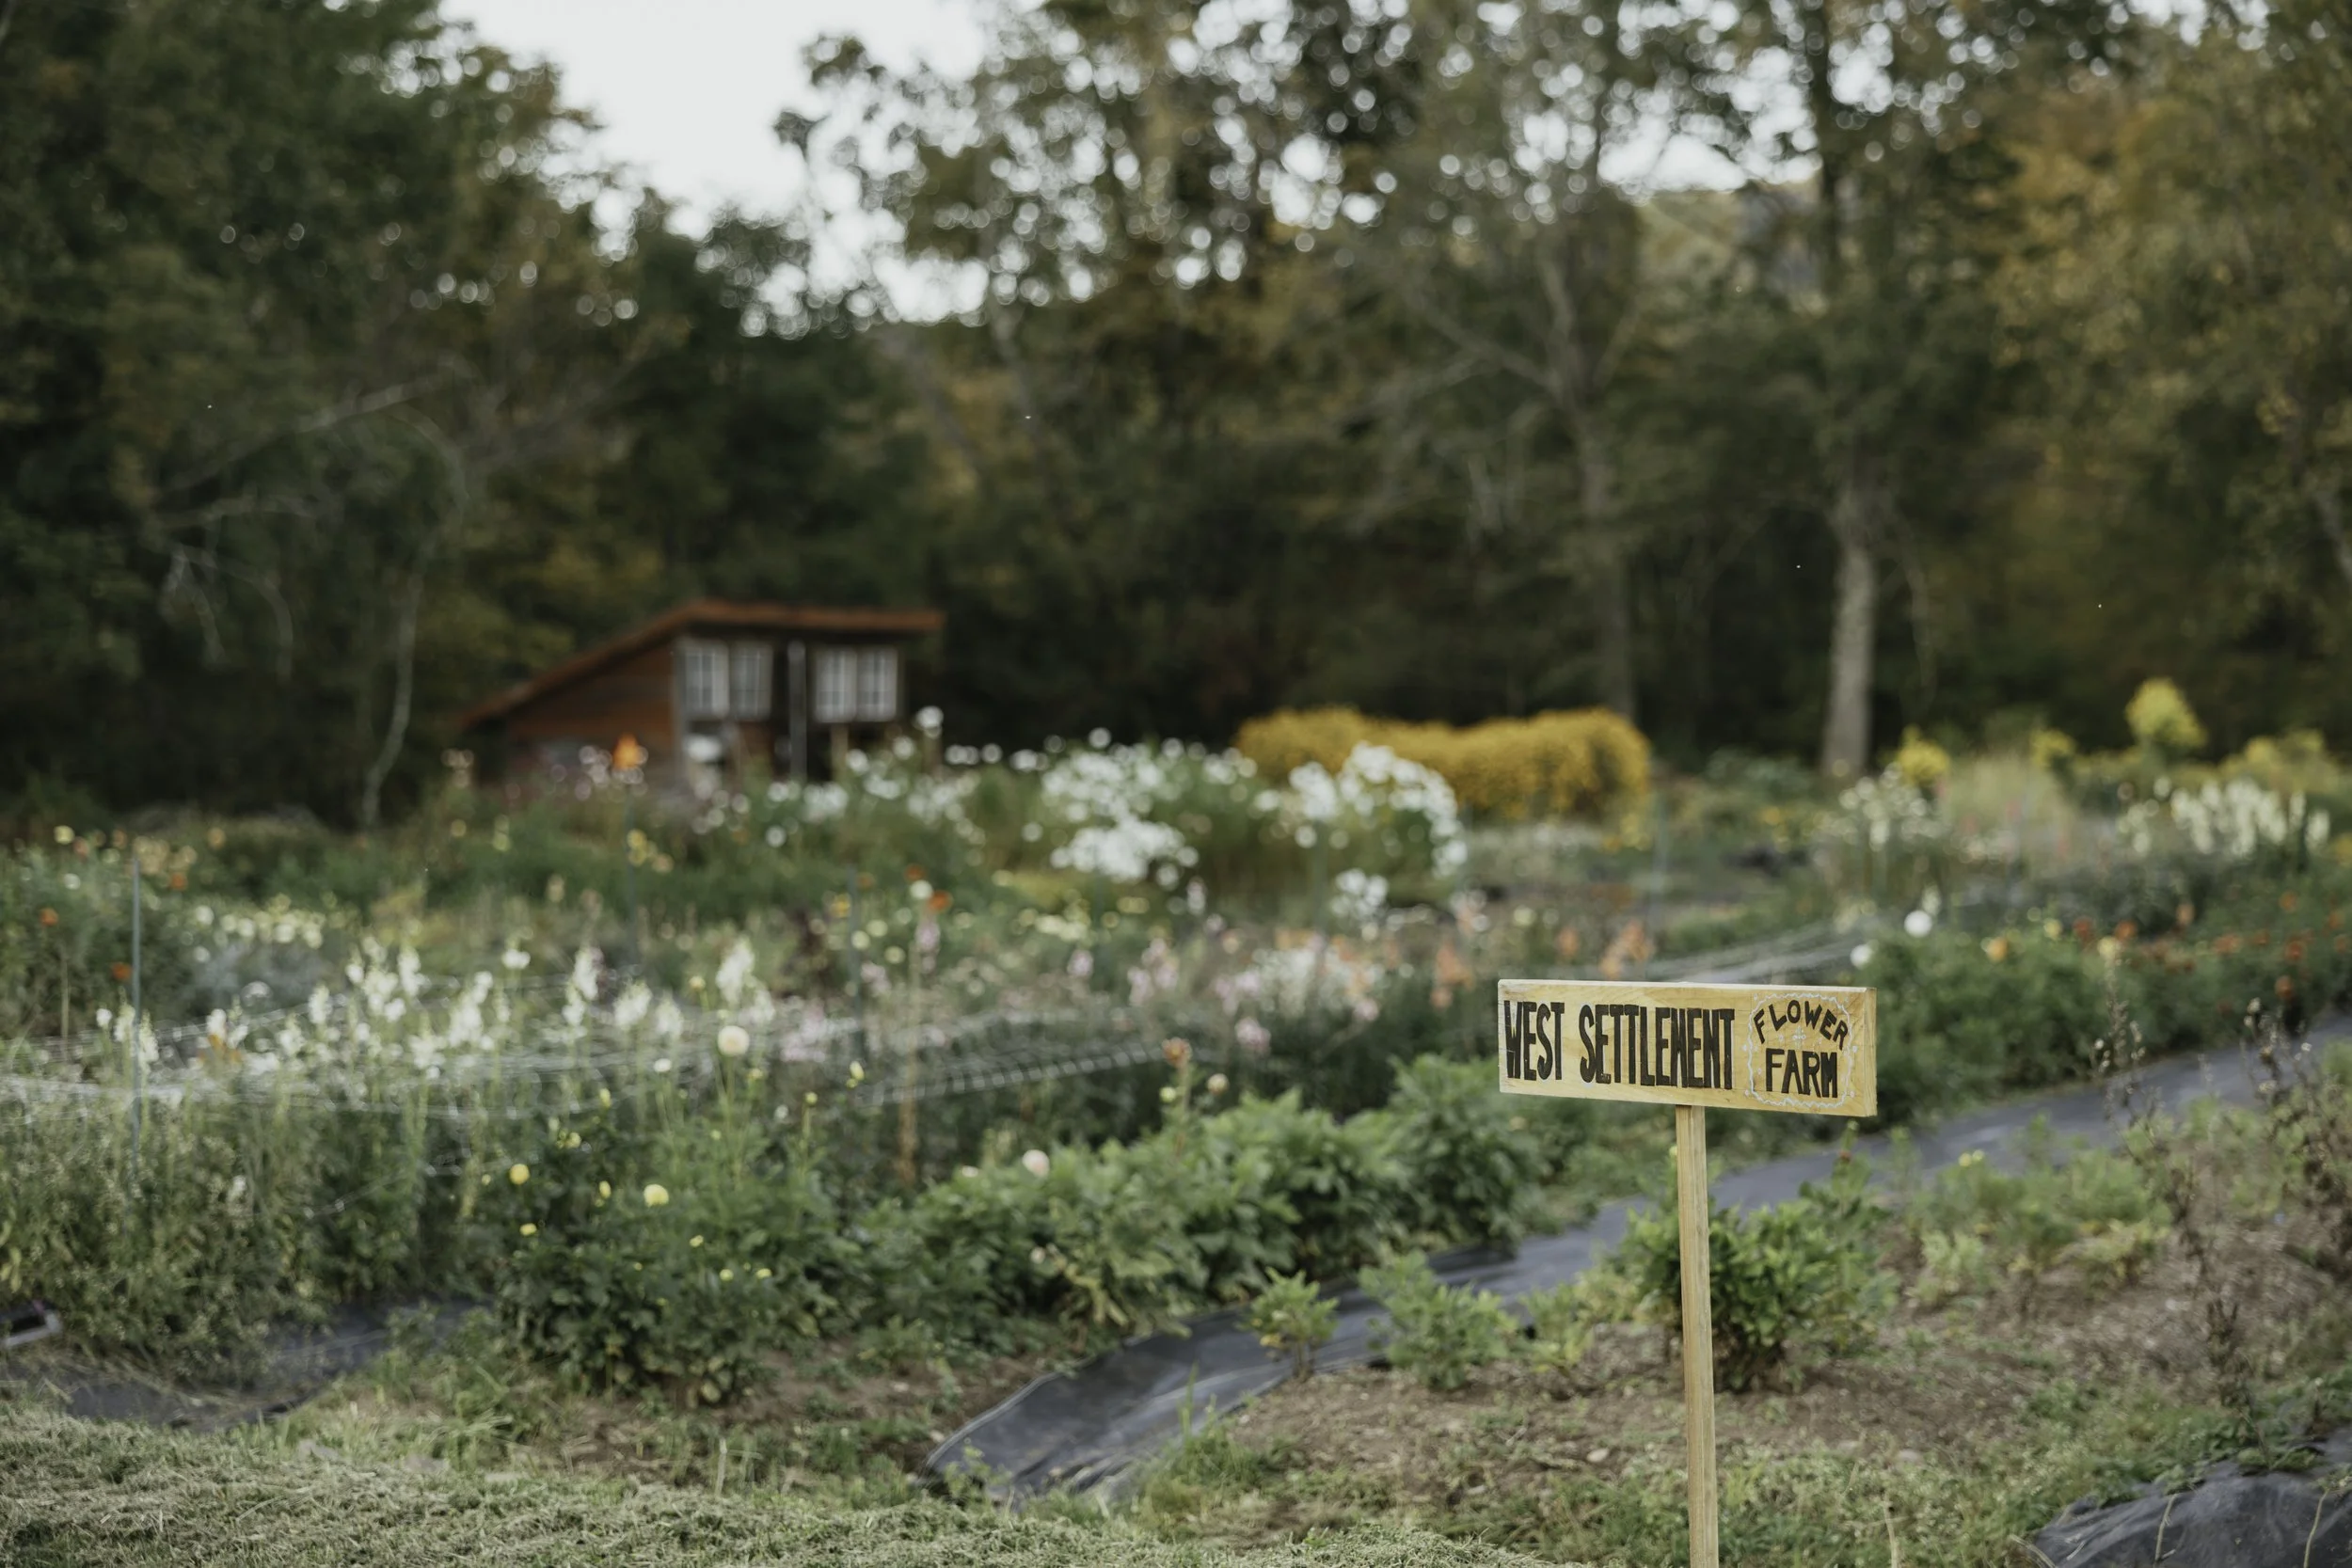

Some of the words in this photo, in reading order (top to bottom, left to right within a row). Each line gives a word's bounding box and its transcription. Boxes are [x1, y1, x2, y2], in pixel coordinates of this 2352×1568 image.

[1503, 1000, 1565, 1082] WEST
[1579, 1004, 1735, 1090] SETTLEMENT
[1753, 999, 1849, 1051] FLOWER
[1765, 1047, 1838, 1099] FARM
